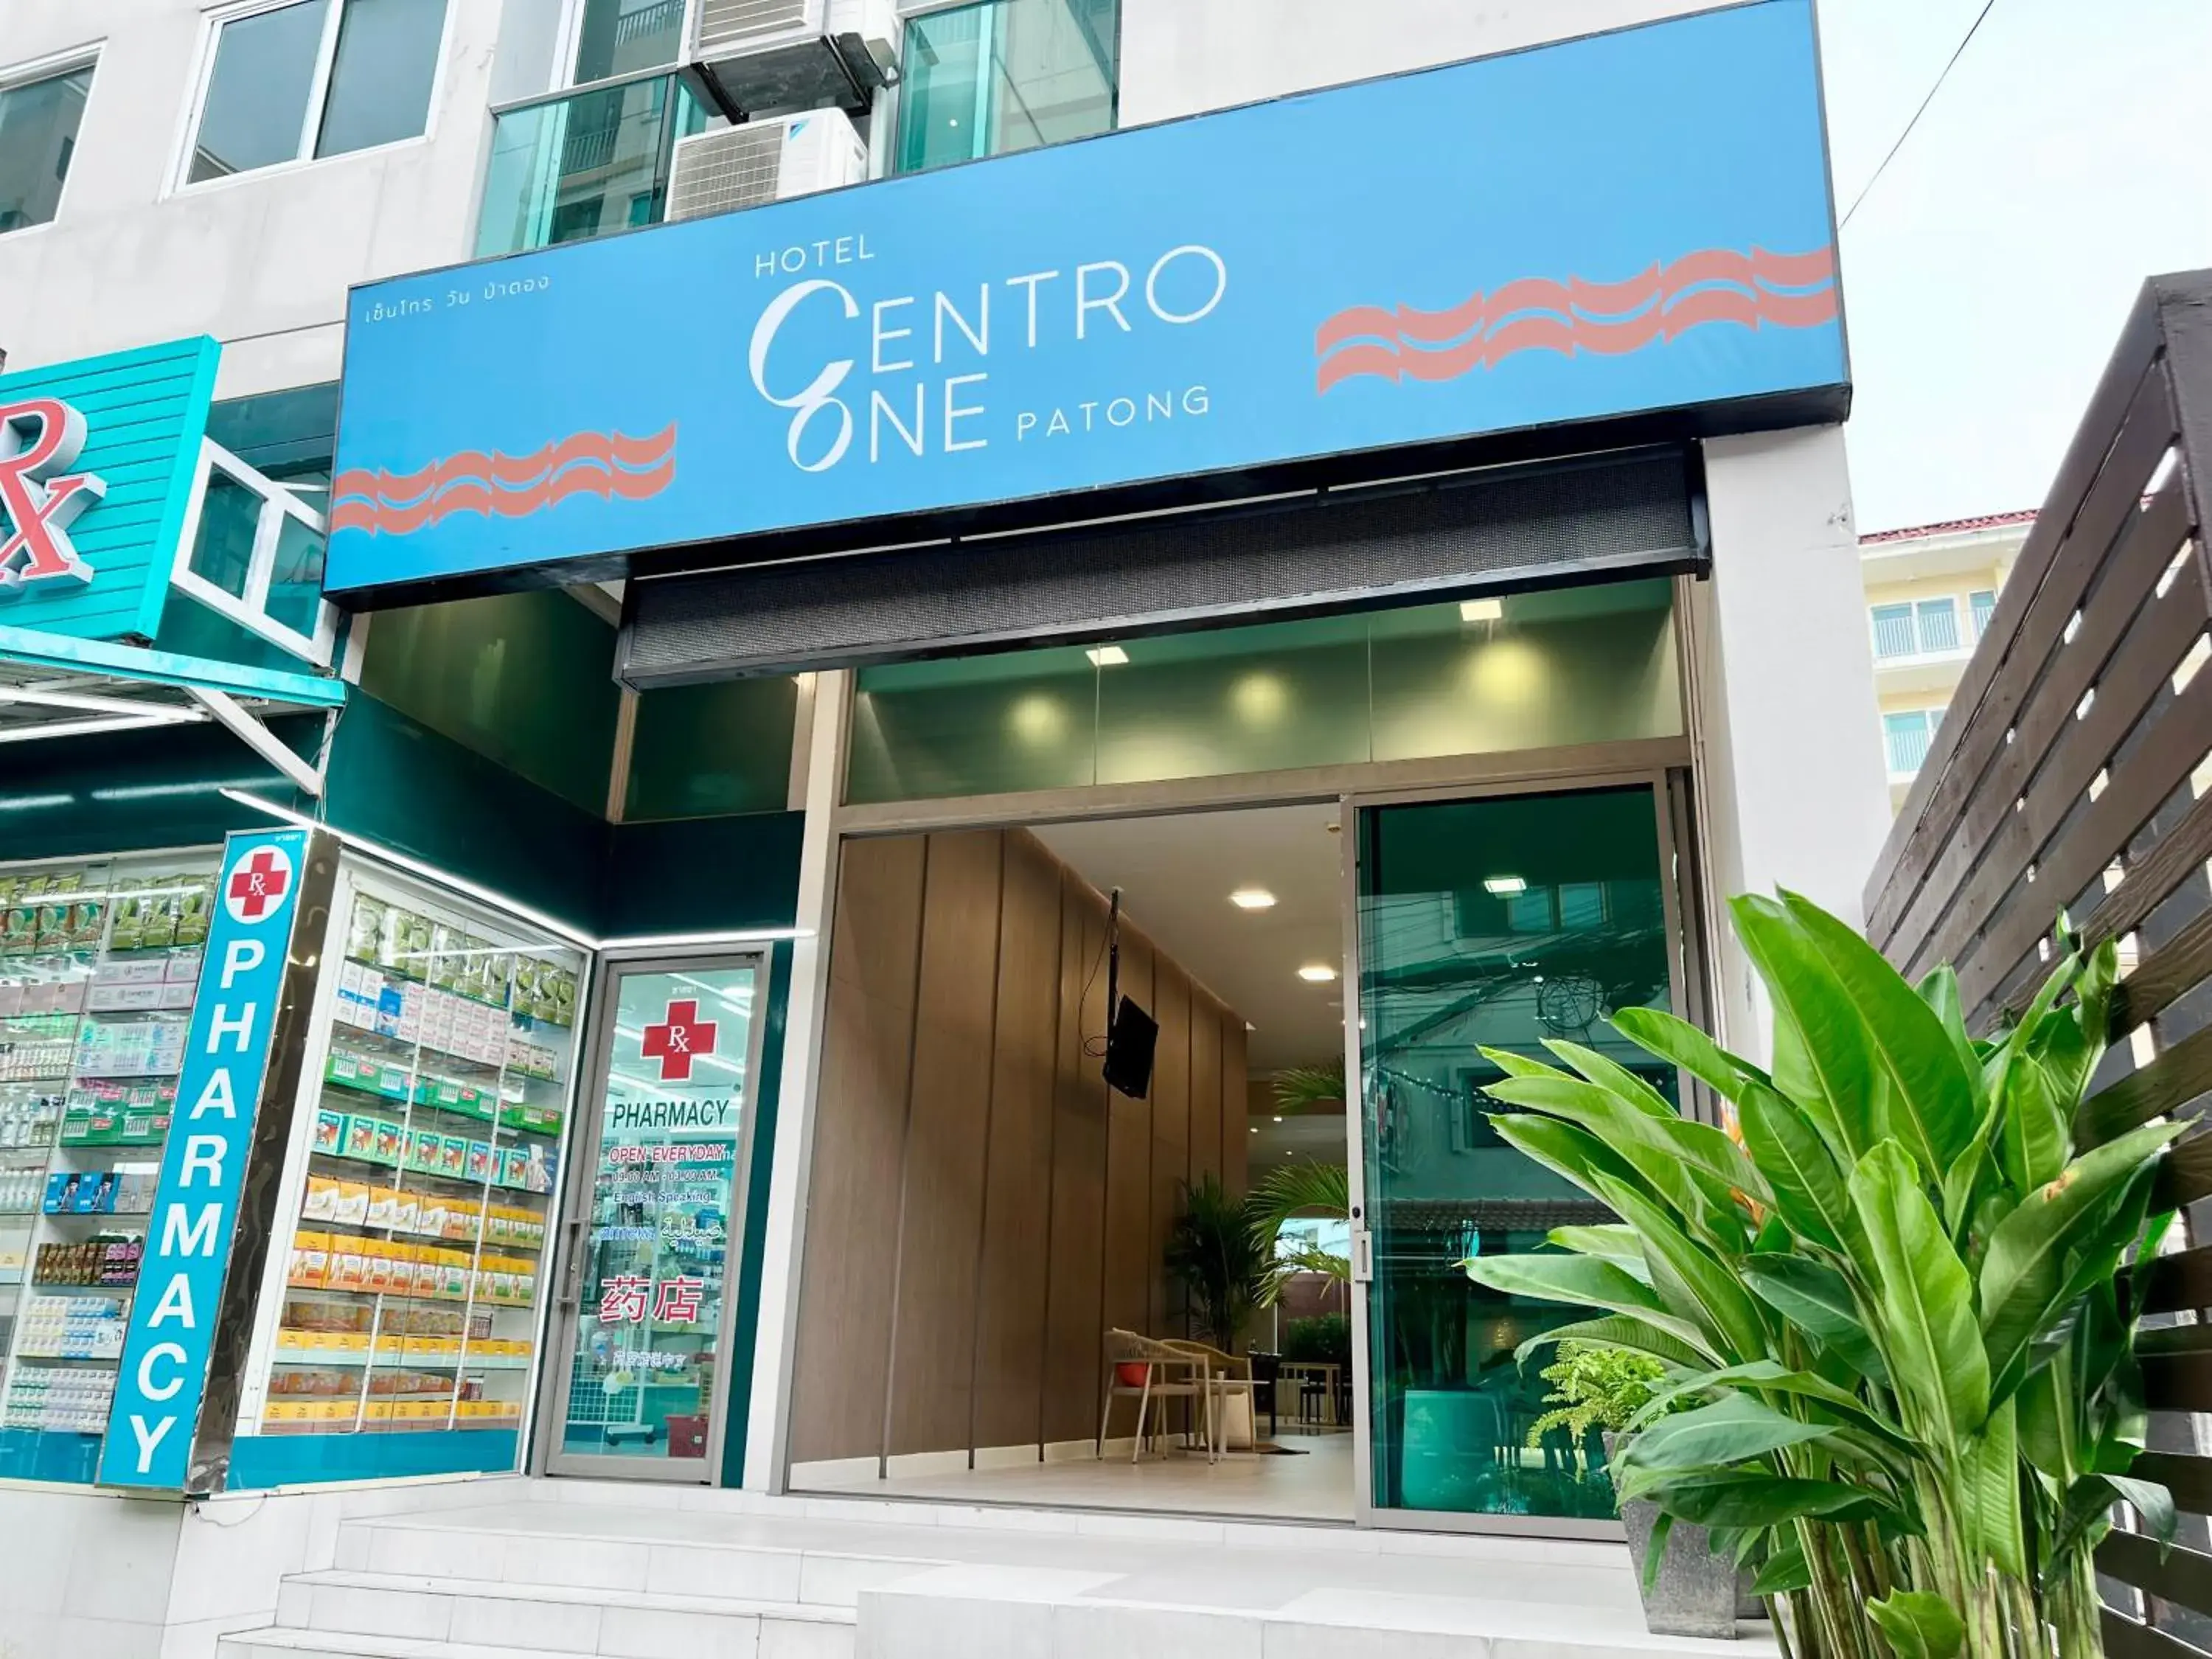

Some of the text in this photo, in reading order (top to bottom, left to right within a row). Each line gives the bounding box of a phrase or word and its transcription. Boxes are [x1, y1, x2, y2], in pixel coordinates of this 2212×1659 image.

[755, 234, 874, 279] HOTEL
[748, 245, 1226, 407] CENTRO
[787, 372, 1209, 472] ONE PATONG
[612, 1099, 729, 1129] PHARMACY
[609, 1147, 647, 1163] OPEN
[653, 1144, 726, 1162] EVERYDAY
[129, 939, 265, 1474] PHARMACY
[613, 1191, 712, 1206] English Speaking
[600, 1275, 703, 1324] 药店
